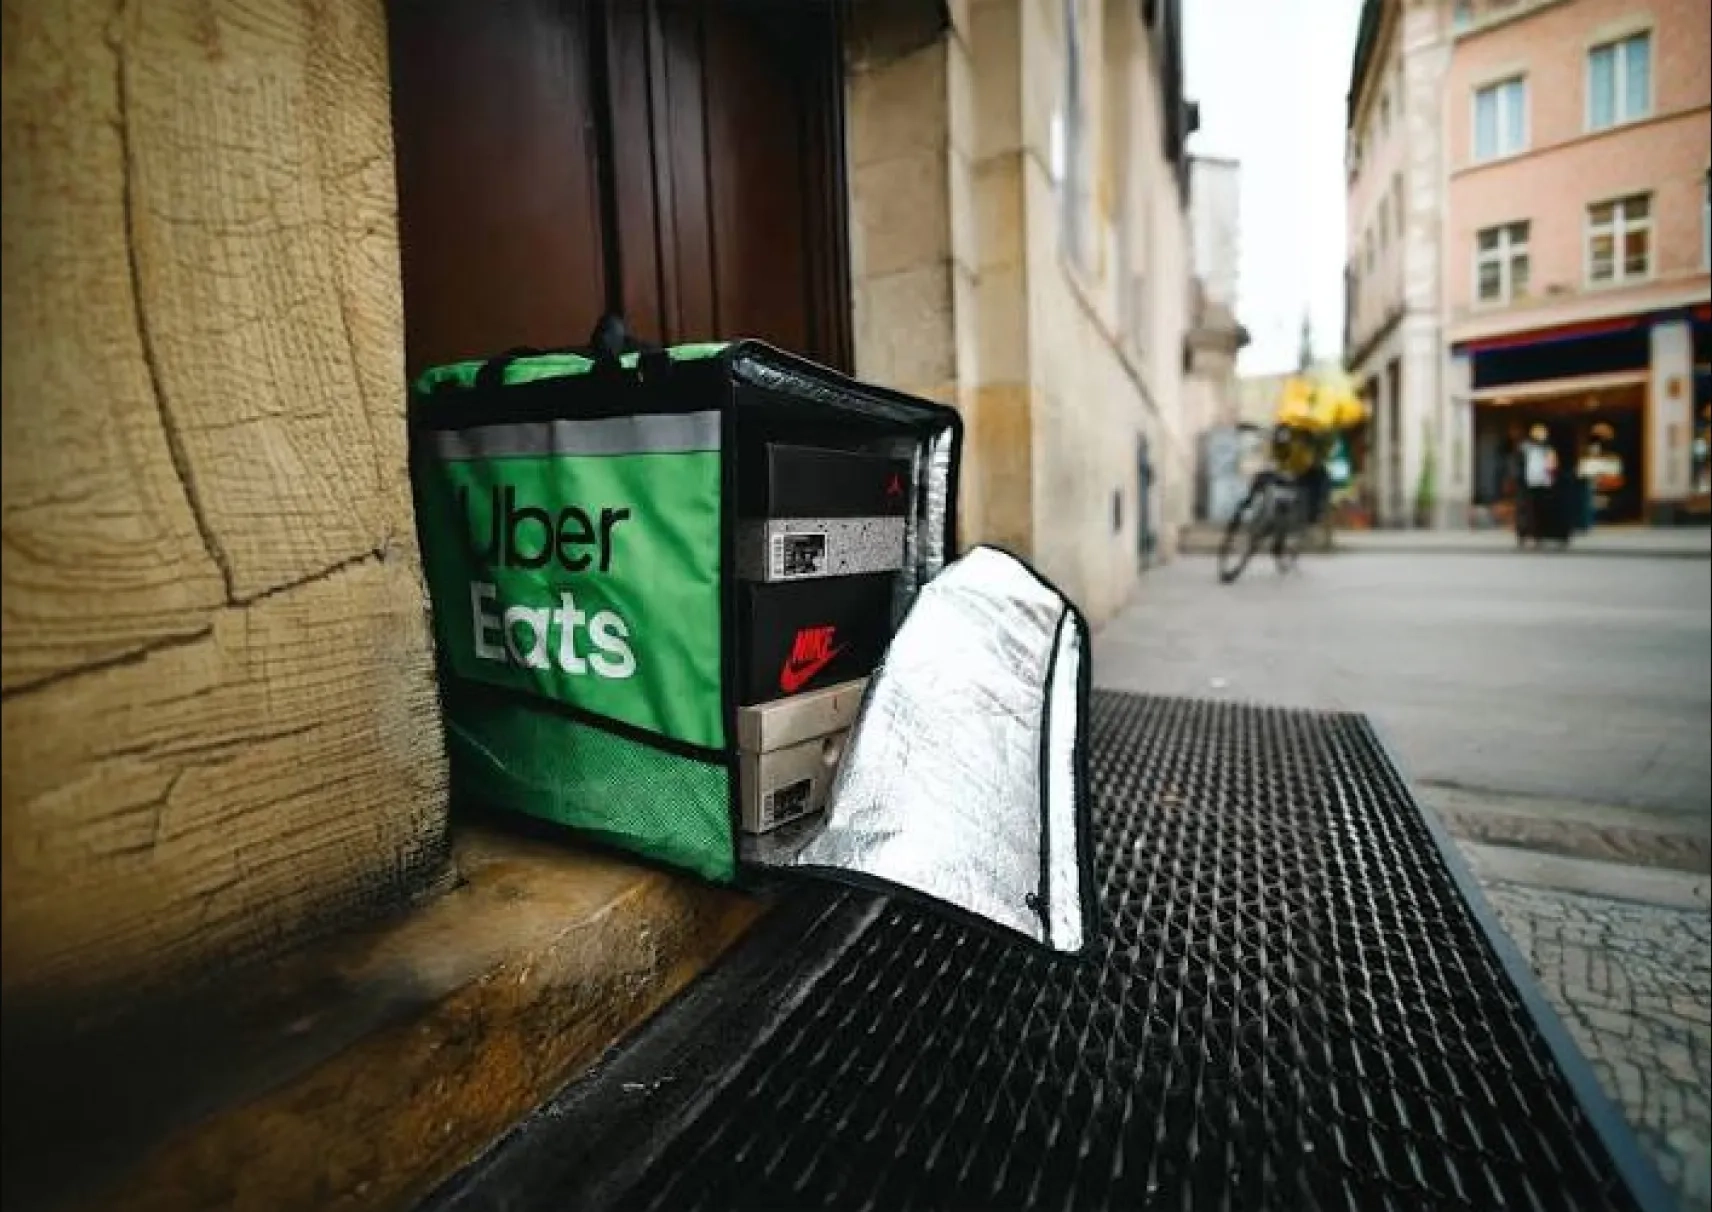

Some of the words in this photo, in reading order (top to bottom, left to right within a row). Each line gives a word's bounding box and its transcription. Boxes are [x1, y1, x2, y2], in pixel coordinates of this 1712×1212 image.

[456, 485, 631, 572] Uber
[470, 580, 637, 679] Eats
[793, 626, 835, 662] NIKE
